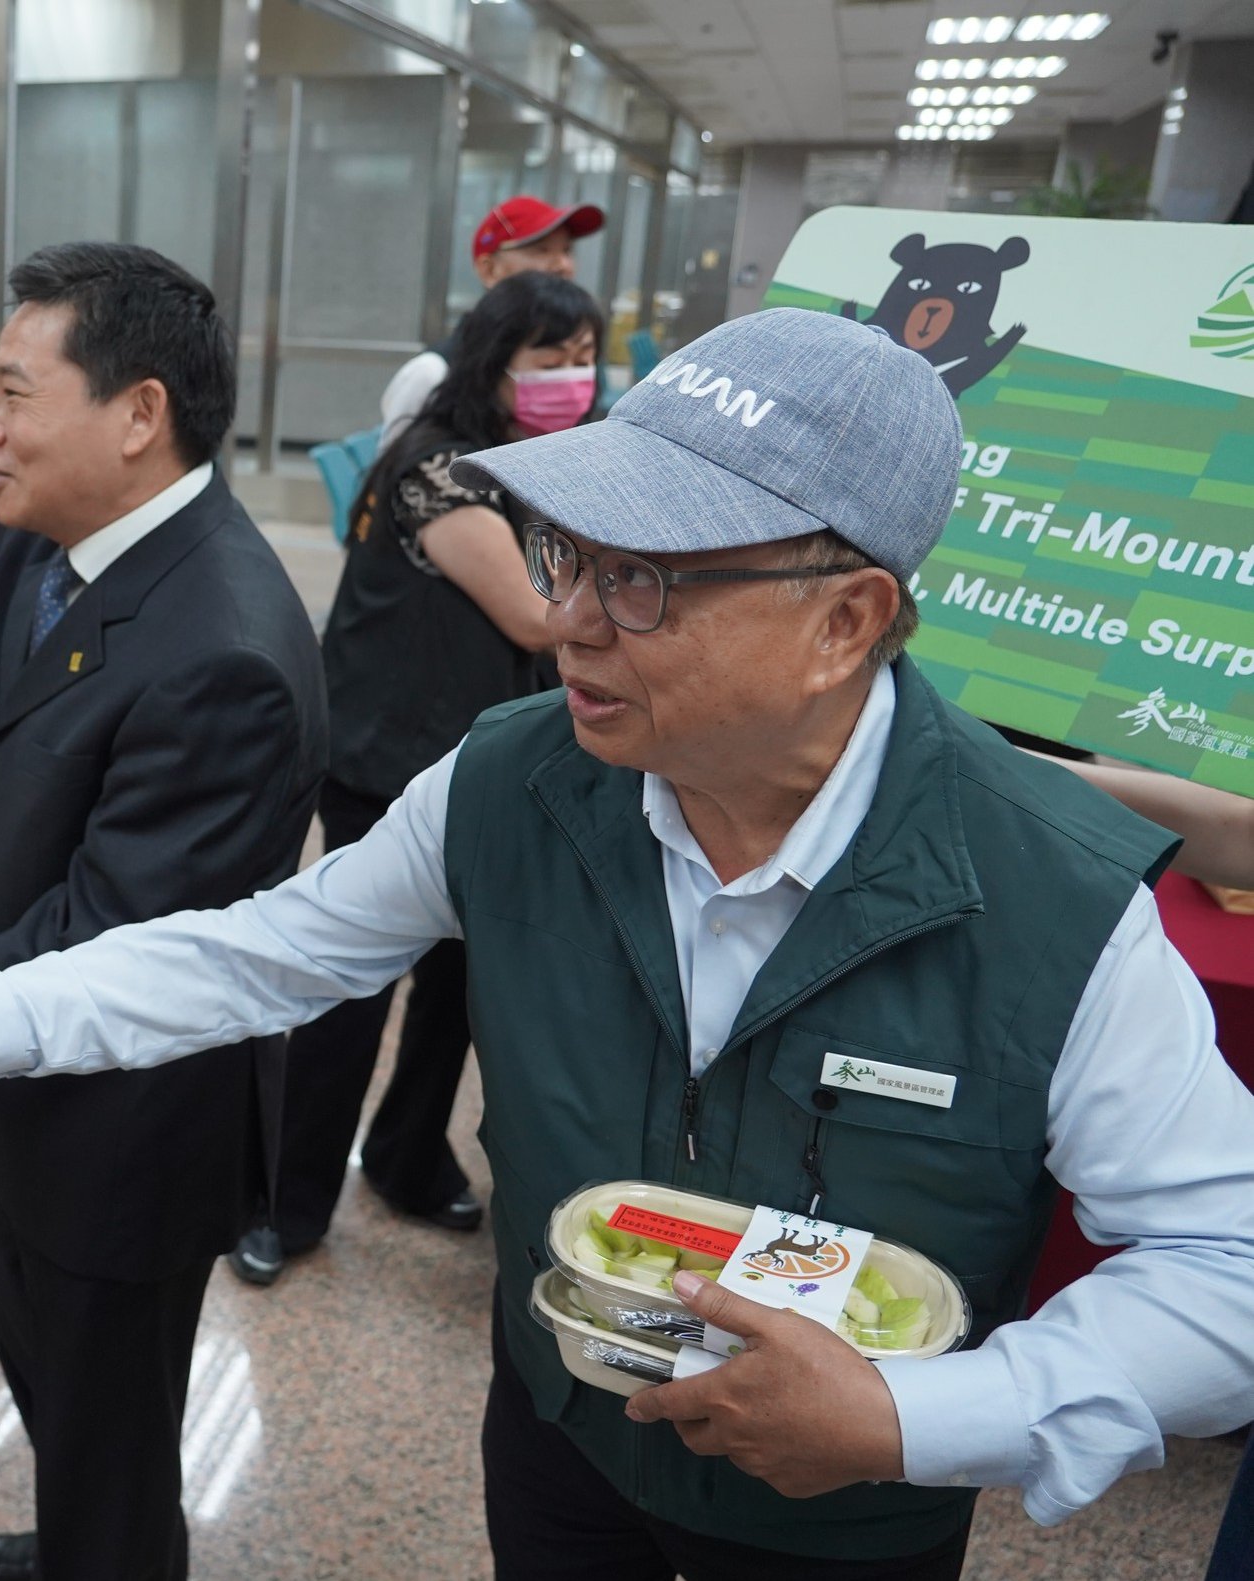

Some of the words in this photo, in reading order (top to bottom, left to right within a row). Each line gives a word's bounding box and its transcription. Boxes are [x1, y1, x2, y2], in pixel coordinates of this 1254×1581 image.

[941, 572, 1128, 645] Multiple
[1168, 725, 1251, 760] 國家風景區
[1186, 720, 1241, 741] Tri-Mountain
[876, 1076, 946, 1098] 國家風景區管理處
